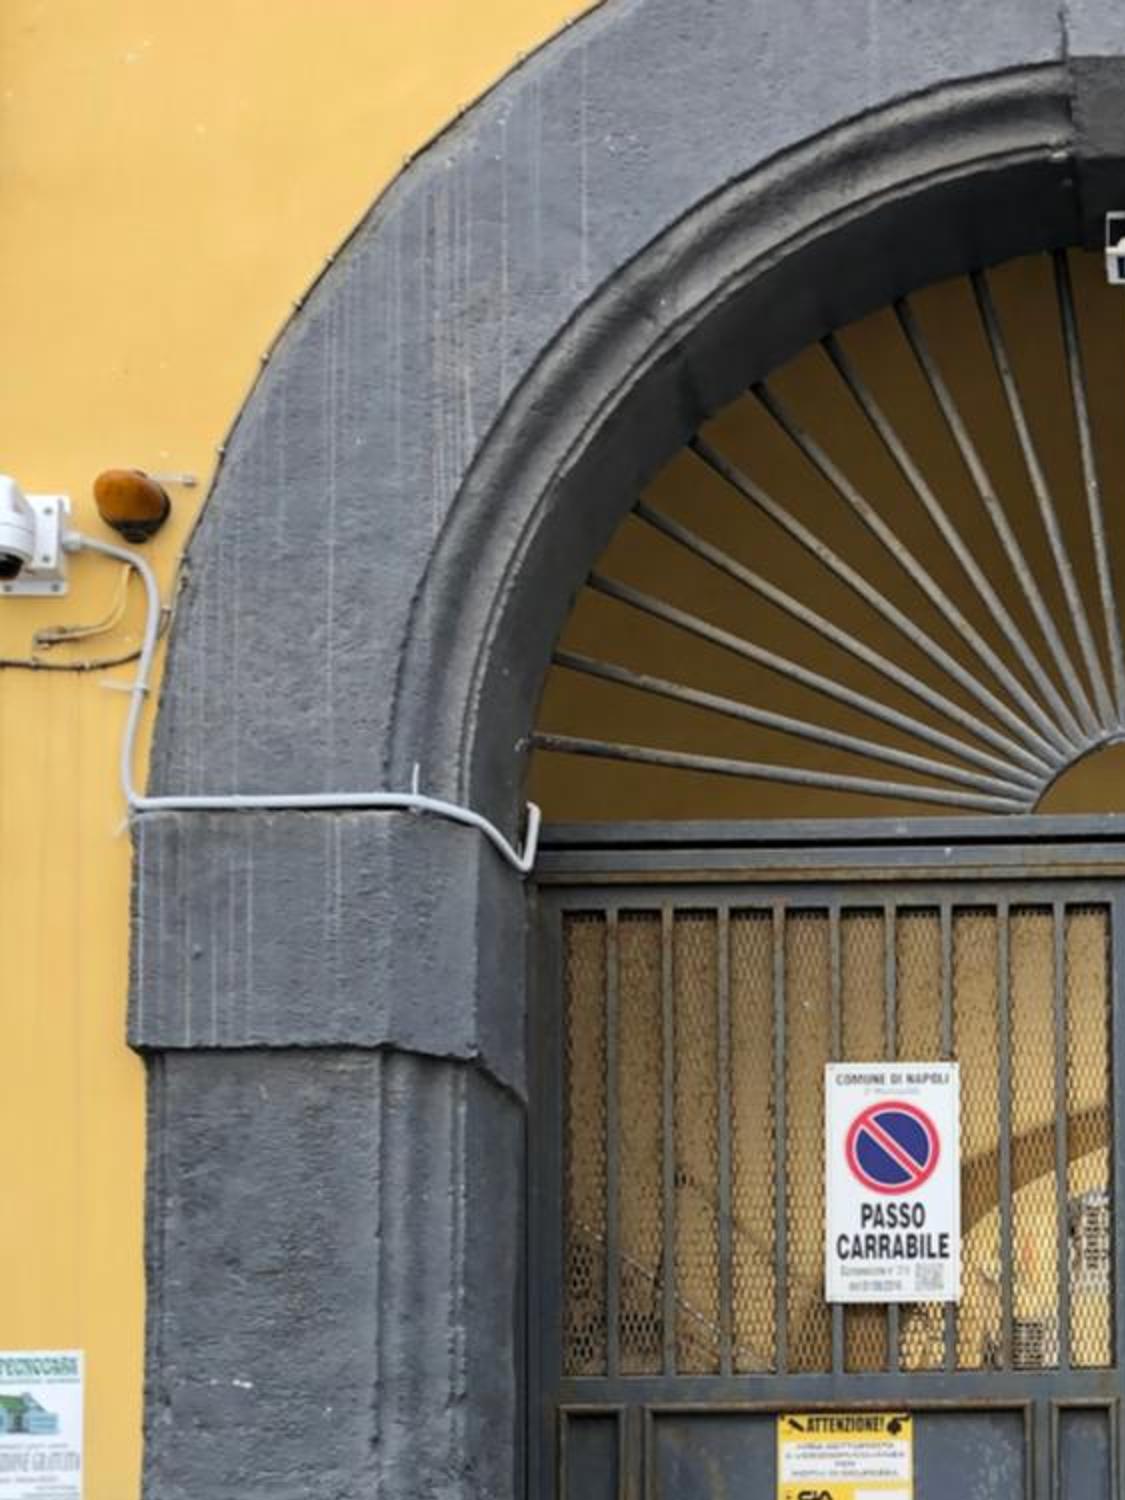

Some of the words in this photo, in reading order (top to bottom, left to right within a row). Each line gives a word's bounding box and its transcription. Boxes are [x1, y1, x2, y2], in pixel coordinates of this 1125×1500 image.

[835, 1073, 885, 1086] COMUNE
[891, 1072, 902, 1085] DI
[906, 1071, 950, 1085] NAPOLI
[860, 1203, 926, 1228] PASSO
[836, 1233, 950, 1260] CARRABILE
[806, 1416, 885, 1433] ATTENZIONE!
